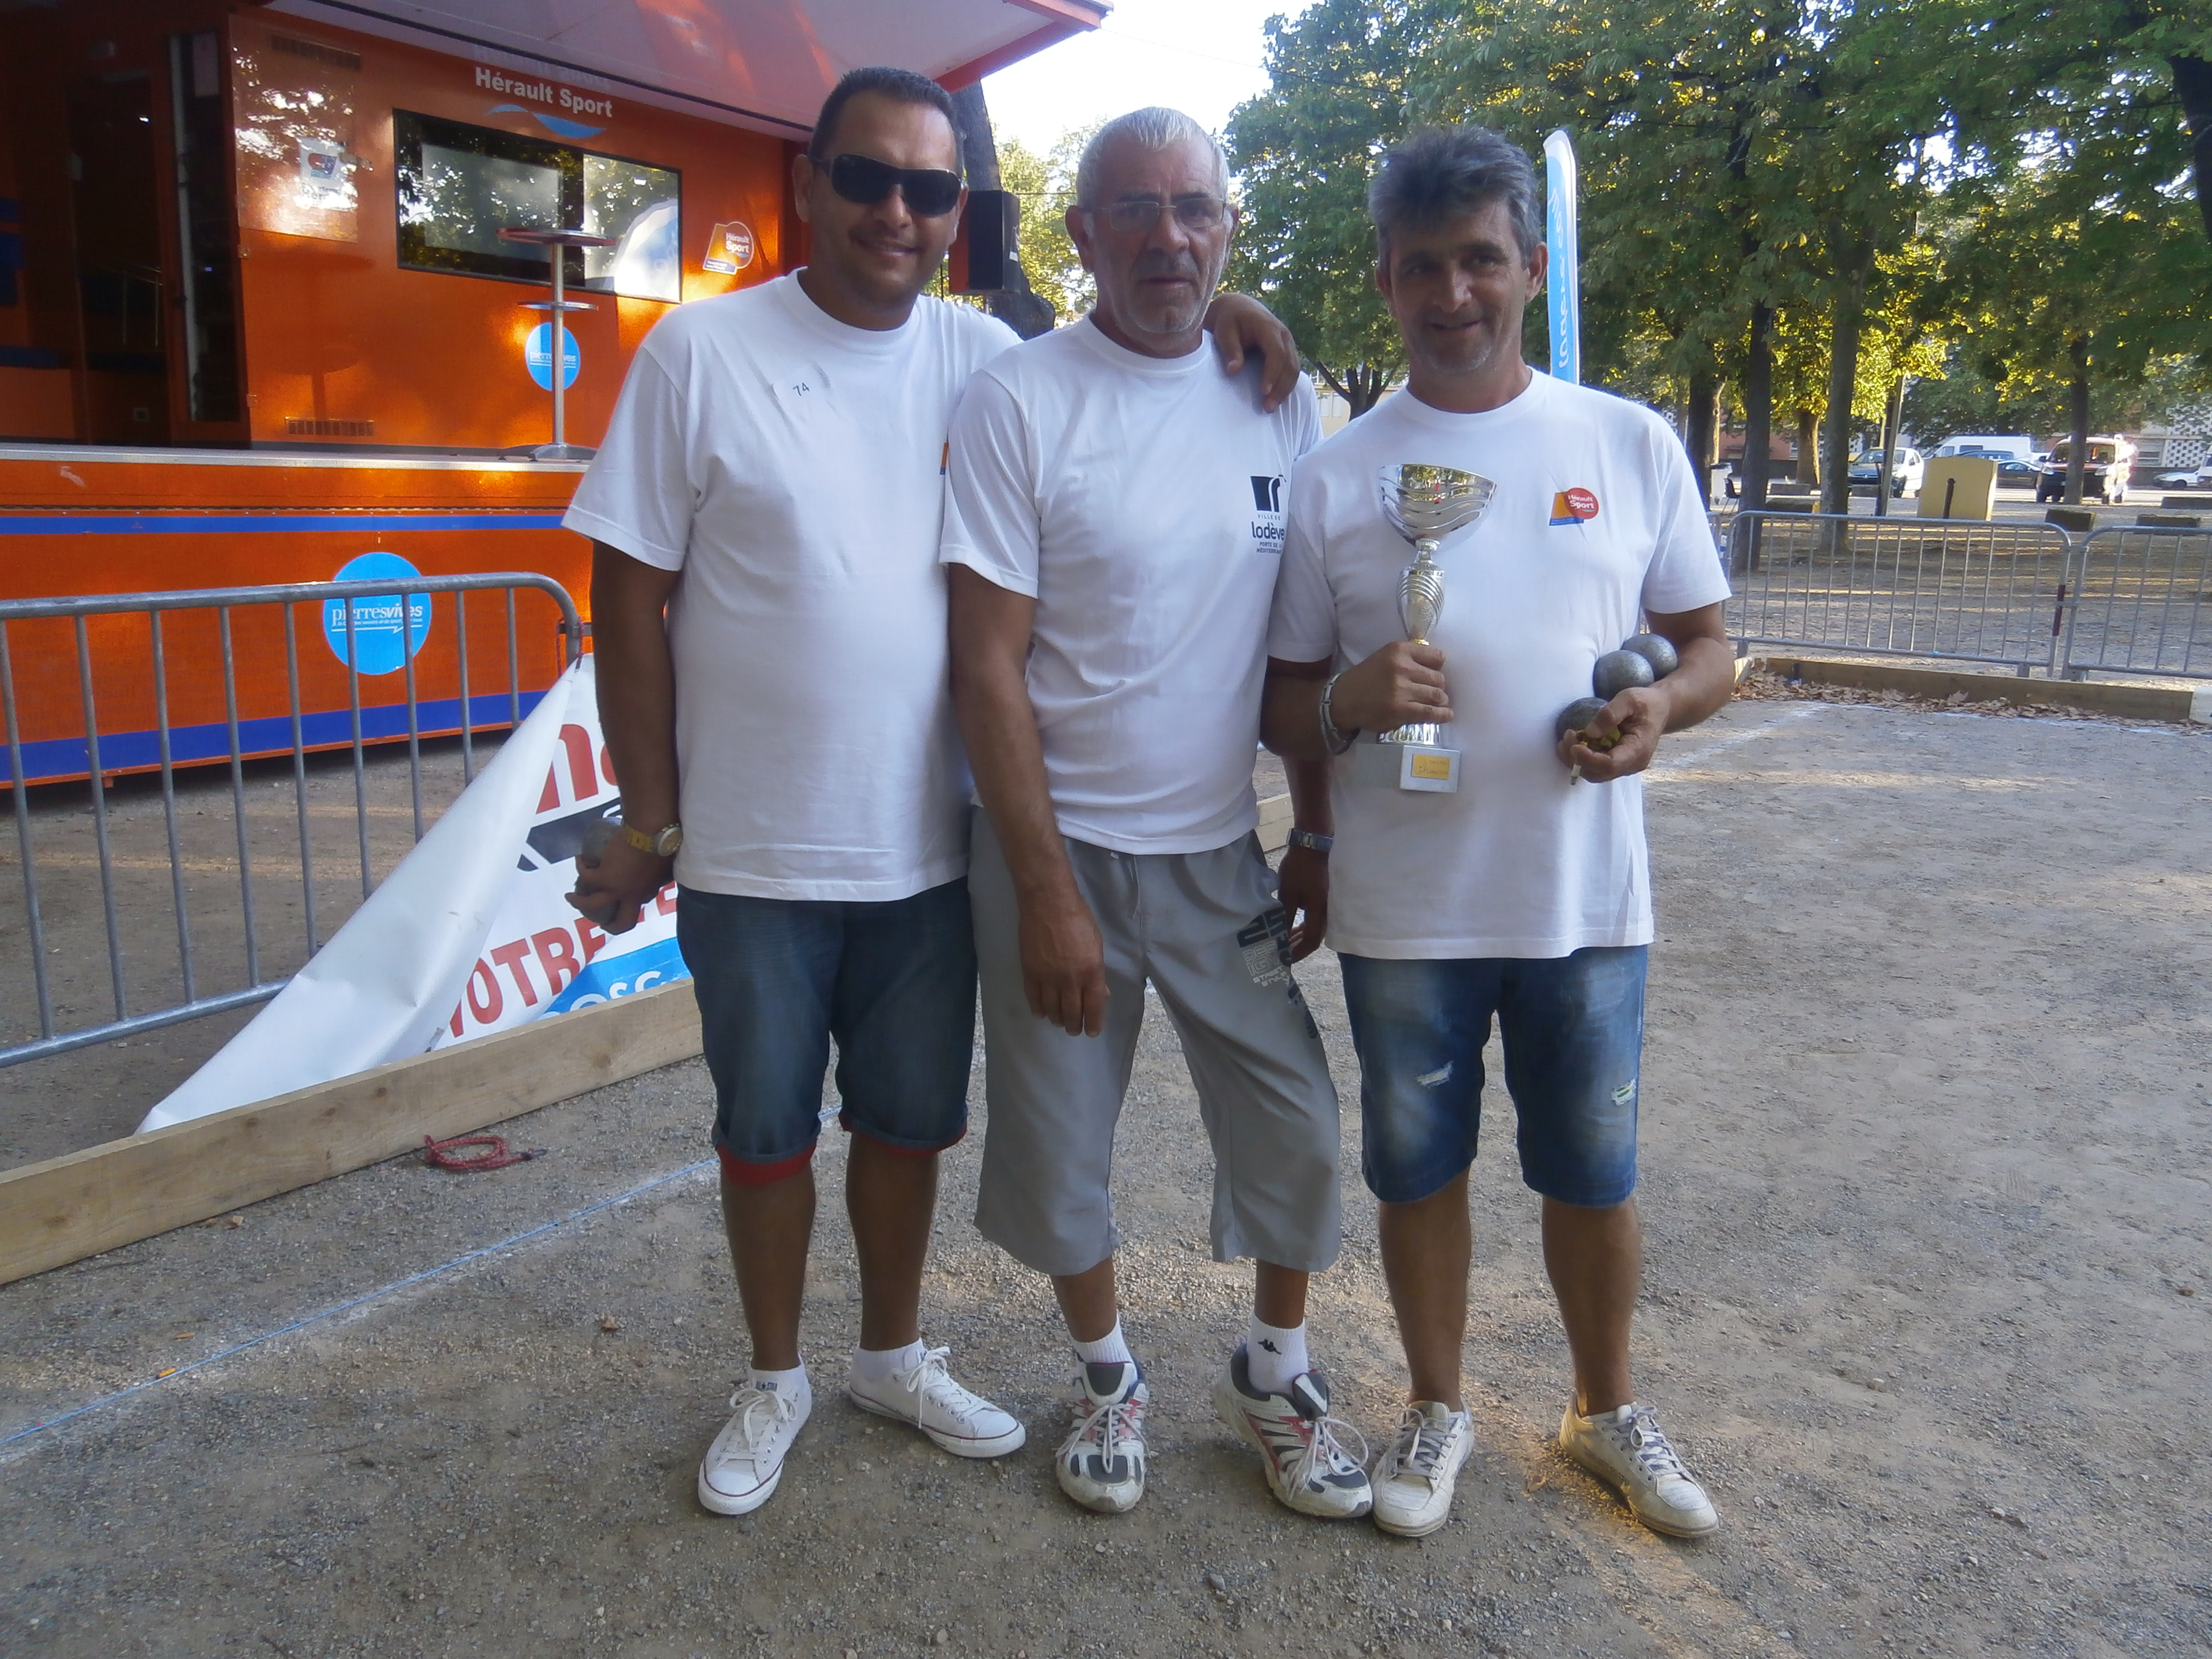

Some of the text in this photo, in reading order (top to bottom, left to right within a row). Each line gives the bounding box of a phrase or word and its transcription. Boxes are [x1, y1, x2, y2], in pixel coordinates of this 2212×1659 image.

[475, 67, 613, 118] Hérault Sport
[725, 240, 750, 254] Sport
[792, 382, 810, 397] 74
[1569, 500, 1595, 509] Sport
[1251, 521, 1285, 541] lodève
